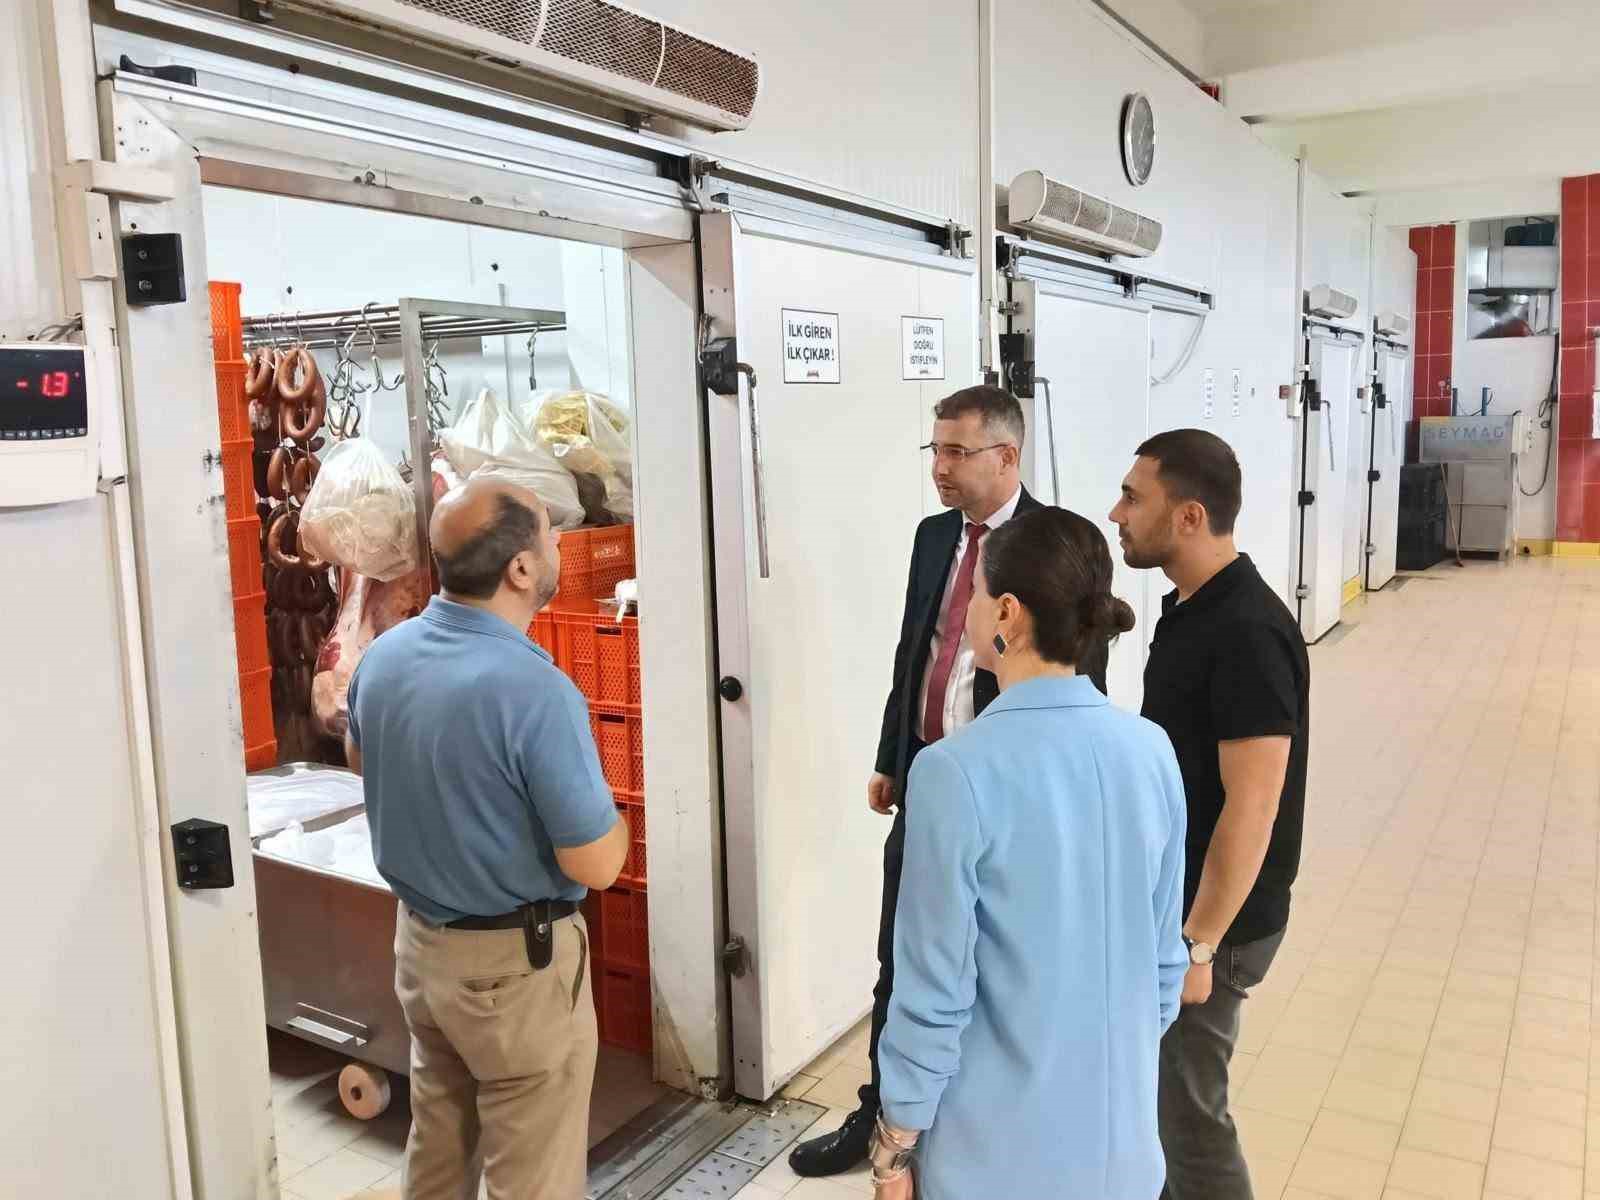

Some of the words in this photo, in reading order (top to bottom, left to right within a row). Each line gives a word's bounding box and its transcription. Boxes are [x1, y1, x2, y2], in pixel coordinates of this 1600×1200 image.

[788, 319, 803, 337] İLK
[804, 321, 832, 340] GİREN
[787, 342, 802, 360] İLK
